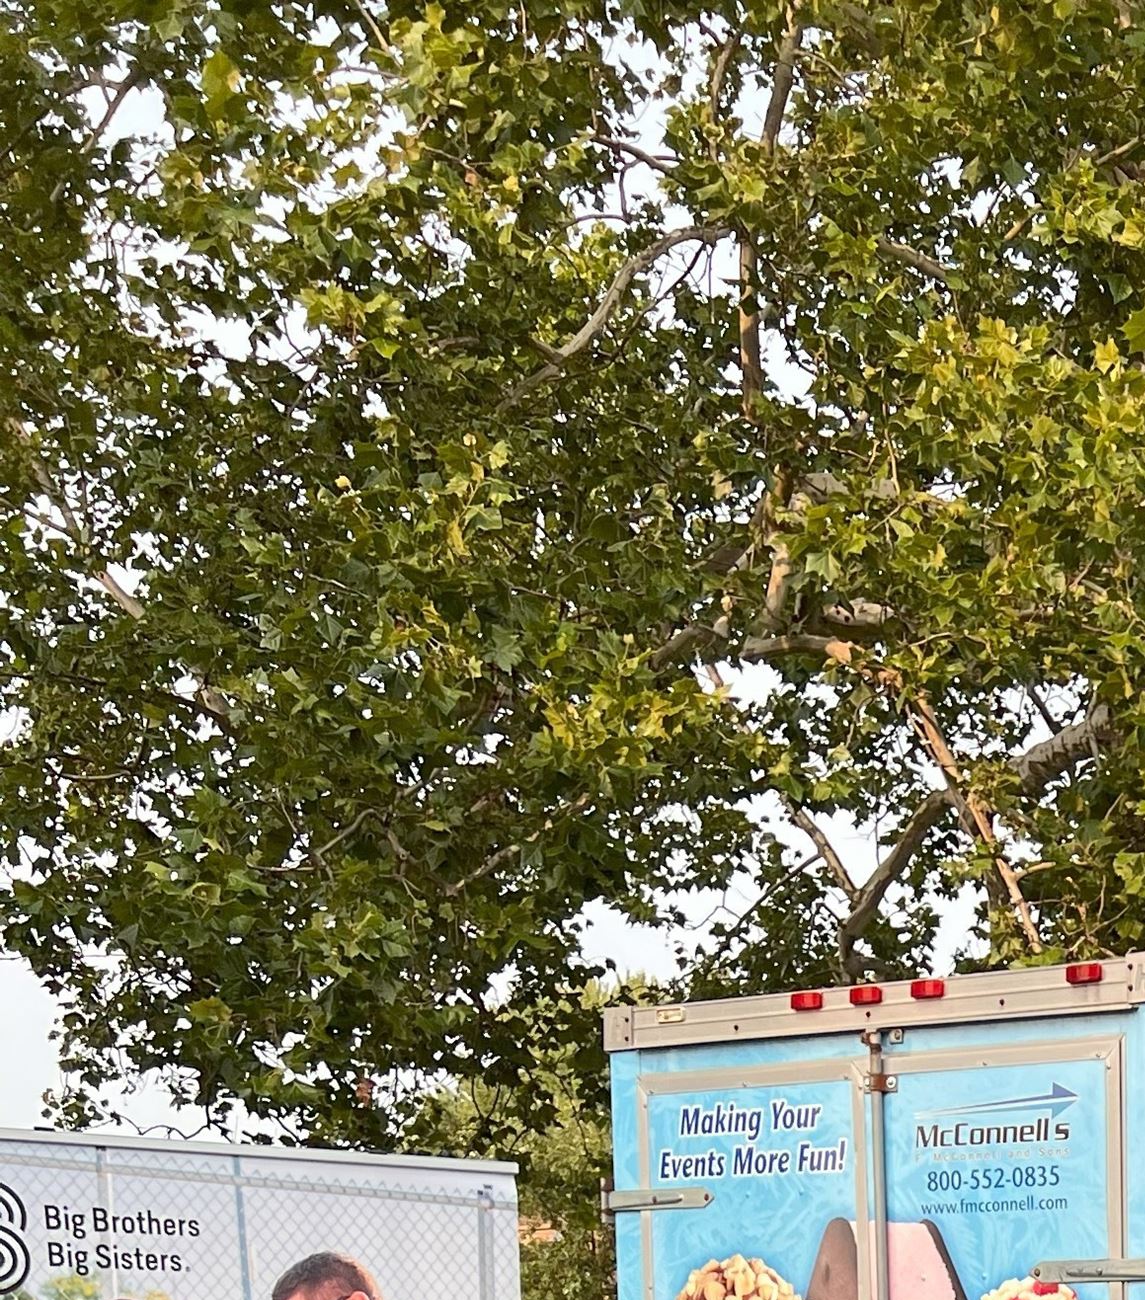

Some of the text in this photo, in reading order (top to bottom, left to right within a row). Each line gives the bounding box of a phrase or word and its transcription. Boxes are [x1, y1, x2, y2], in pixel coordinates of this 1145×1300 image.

[680, 1101, 821, 1140] Making Your
[660, 1140, 846, 1179] Events More Fun!
[927, 1165, 1060, 1192] 800-552-0835
[44, 1204, 200, 1239] Big Brothers
[921, 1196, 1068, 1214] www.fmcconnell.com
[48, 1242, 89, 1276] Big
